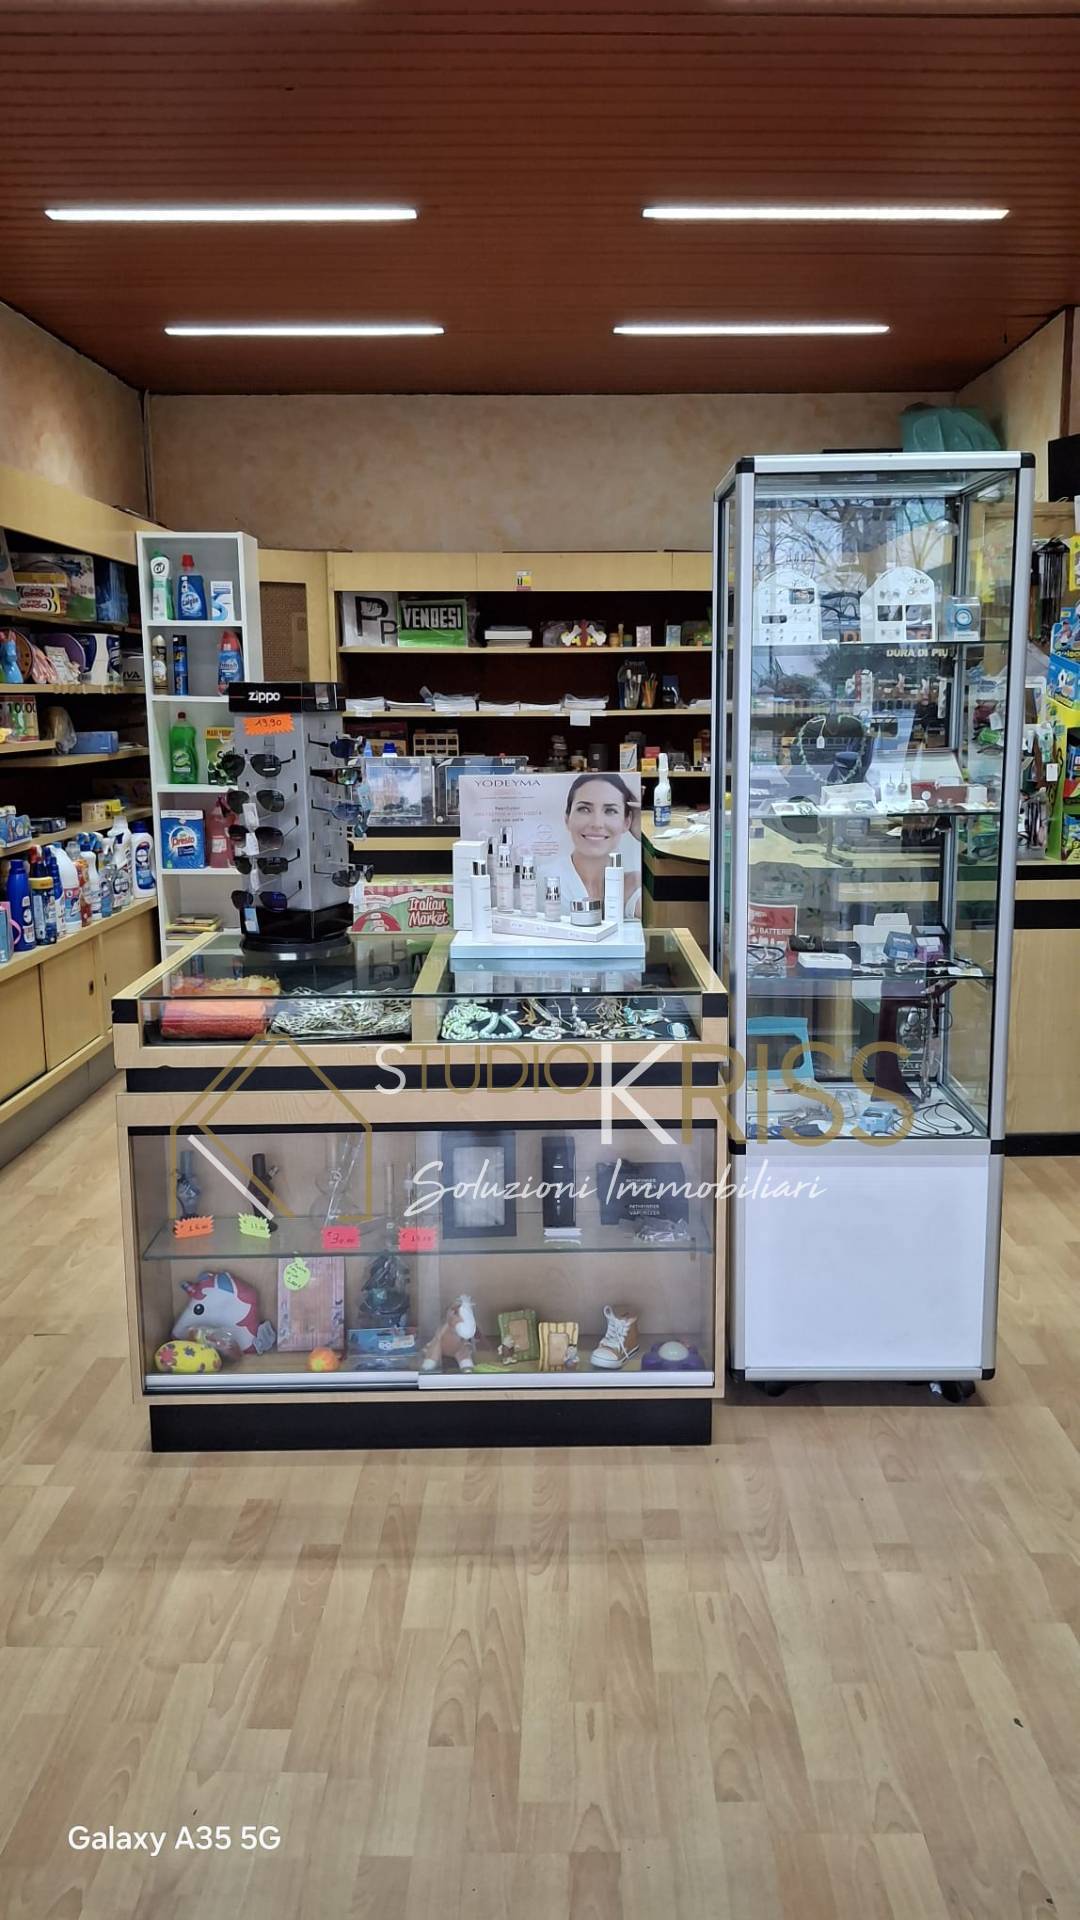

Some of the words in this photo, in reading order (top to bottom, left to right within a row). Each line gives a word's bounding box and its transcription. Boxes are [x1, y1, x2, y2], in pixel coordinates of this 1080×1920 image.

[403, 607, 462, 629] VENDESI
[886, 648, 915, 658] DURA
[917, 648, 929, 658] DI
[248, 690, 281, 704] zippo
[408, 896, 447, 912] Italian
[408, 910, 449, 928] Market
